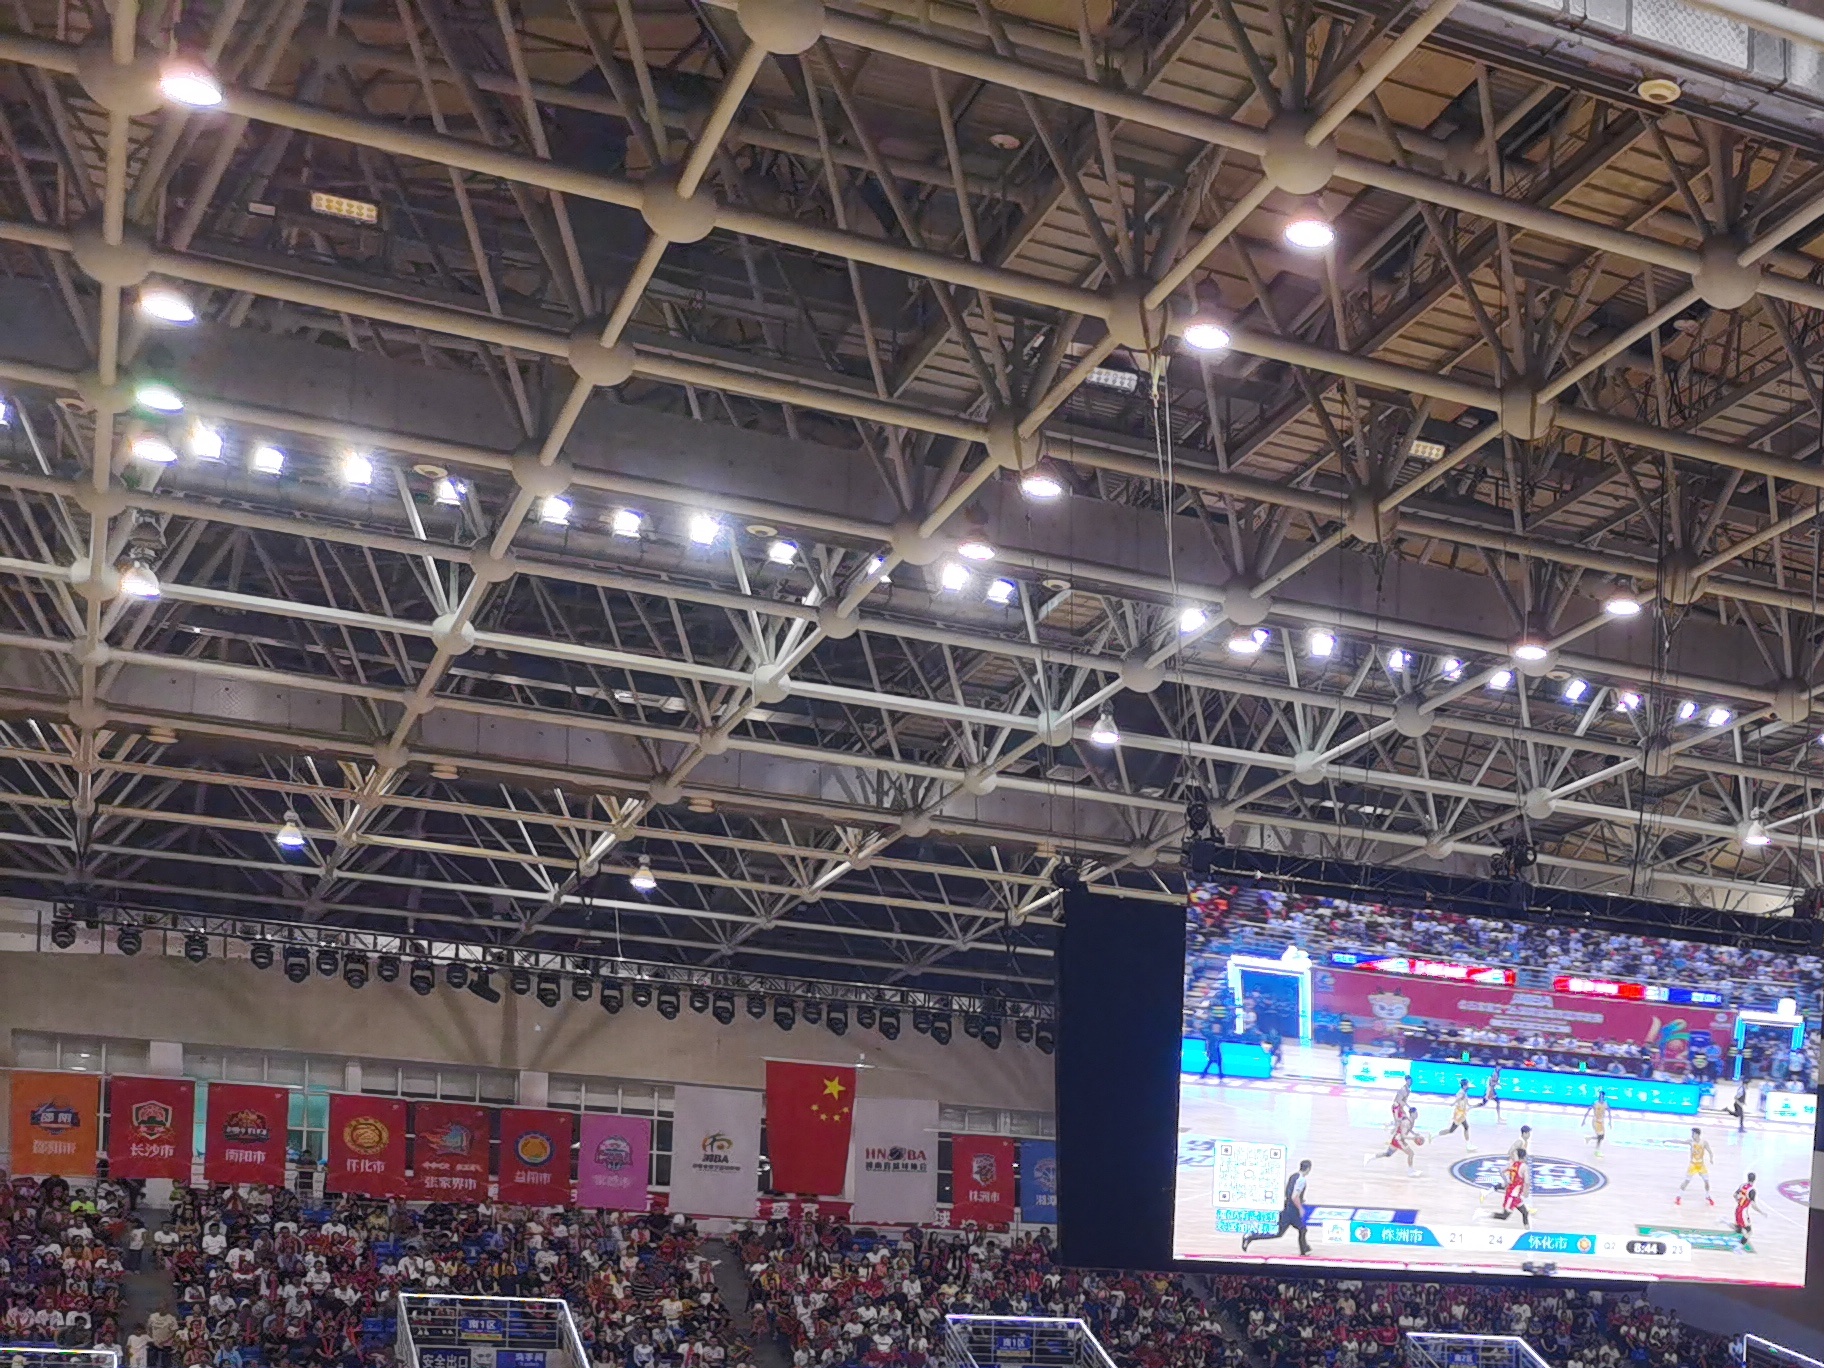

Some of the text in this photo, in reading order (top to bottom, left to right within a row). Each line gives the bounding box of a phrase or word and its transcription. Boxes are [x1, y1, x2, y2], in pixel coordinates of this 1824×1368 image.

[130, 1143, 174, 1159] 长沙市
[346, 1158, 386, 1174] 怀化市
[424, 1175, 477, 1190] 张家界市
[1381, 1226, 1424, 1242] 株洲市
[1450, 1232, 1464, 1243] 21
[1488, 1235, 1503, 1245] 24
[1528, 1234, 1568, 1249] 怀化市
[422, 1353, 470, 1368] 安全出口
